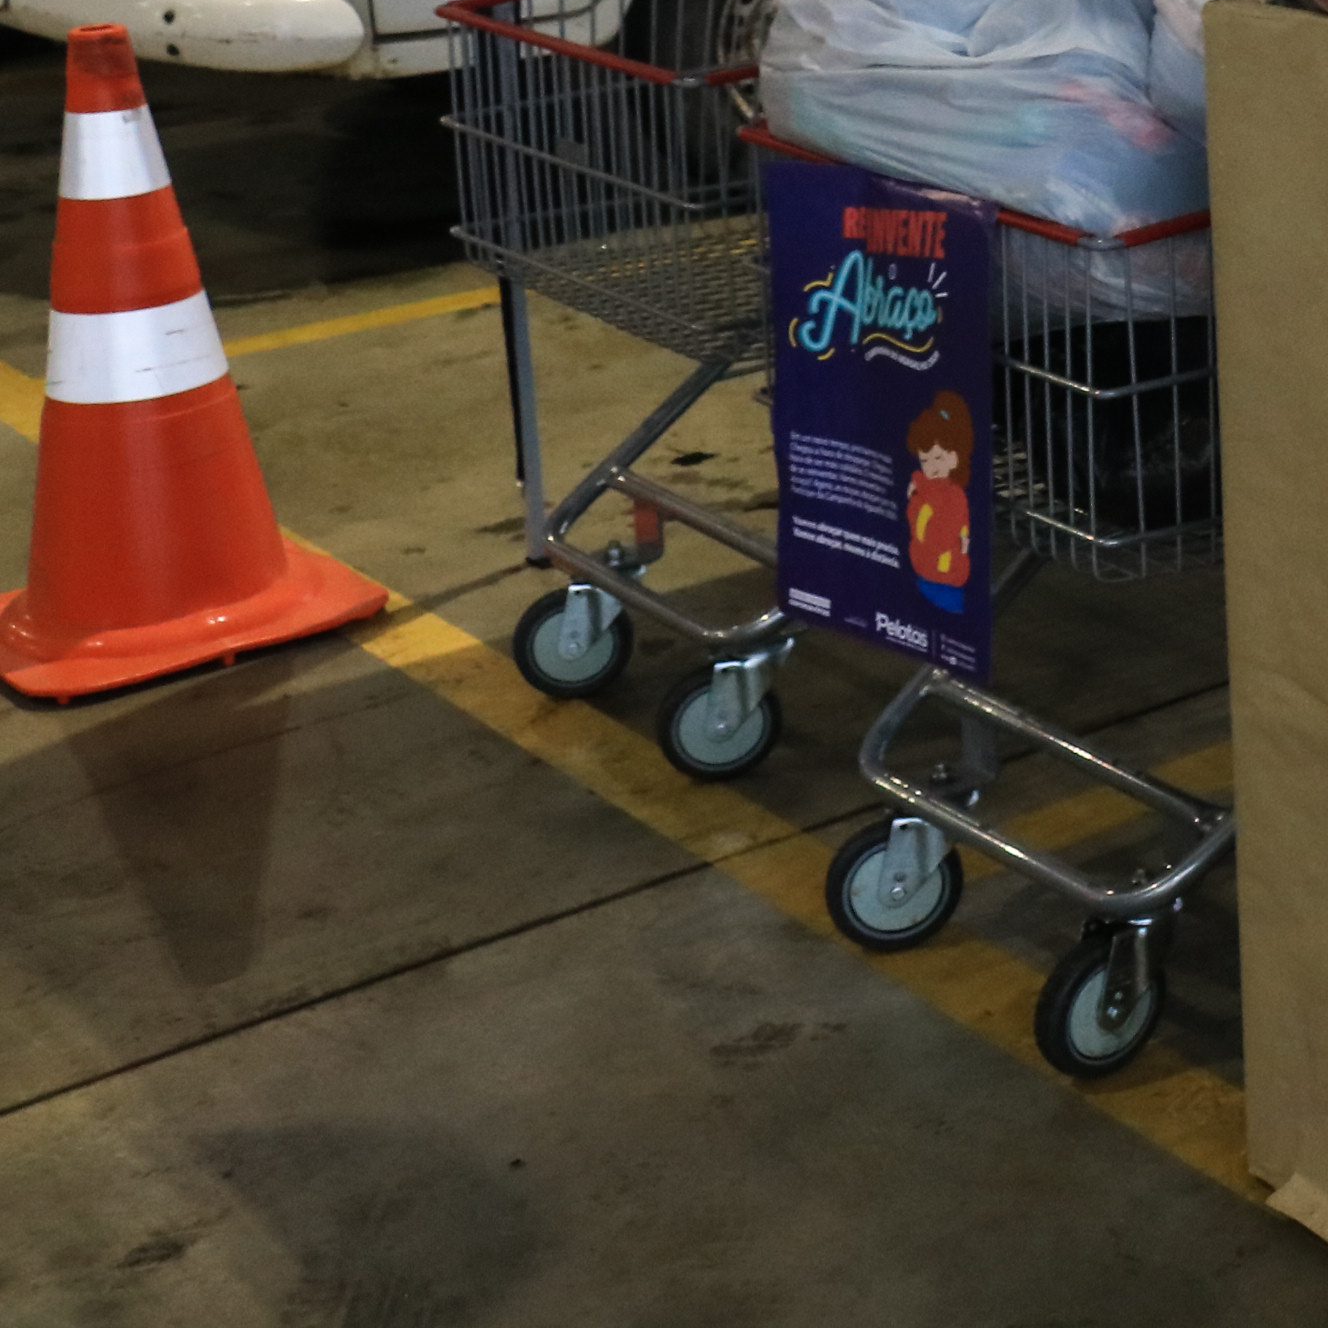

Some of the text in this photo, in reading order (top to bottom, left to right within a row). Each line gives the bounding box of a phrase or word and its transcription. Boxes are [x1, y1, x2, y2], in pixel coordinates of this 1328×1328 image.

[842, 206, 948, 260] REINVENTE
[799, 249, 938, 351] Abraço
[874, 610, 929, 648] Pelotas
